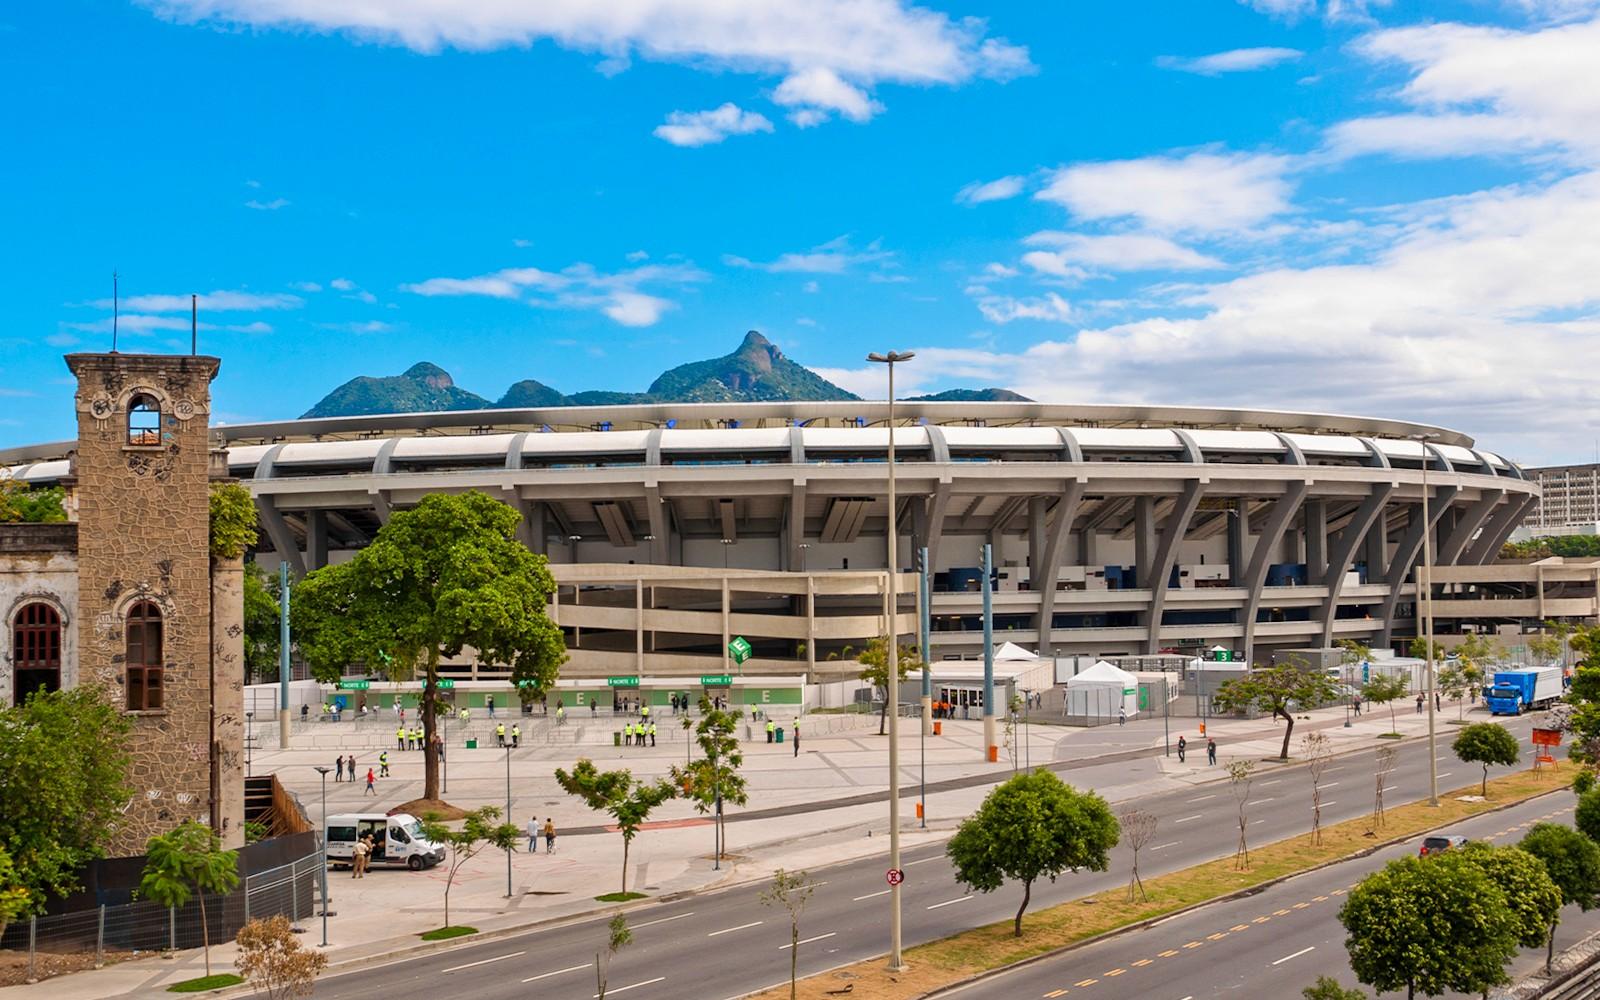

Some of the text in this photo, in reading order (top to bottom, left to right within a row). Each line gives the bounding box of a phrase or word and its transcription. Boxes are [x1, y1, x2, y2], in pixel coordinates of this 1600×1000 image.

[733, 640, 746, 651] E
[1221, 652, 1228, 661] 3
[576, 692, 585, 705] E
[762, 690, 771, 703] E
